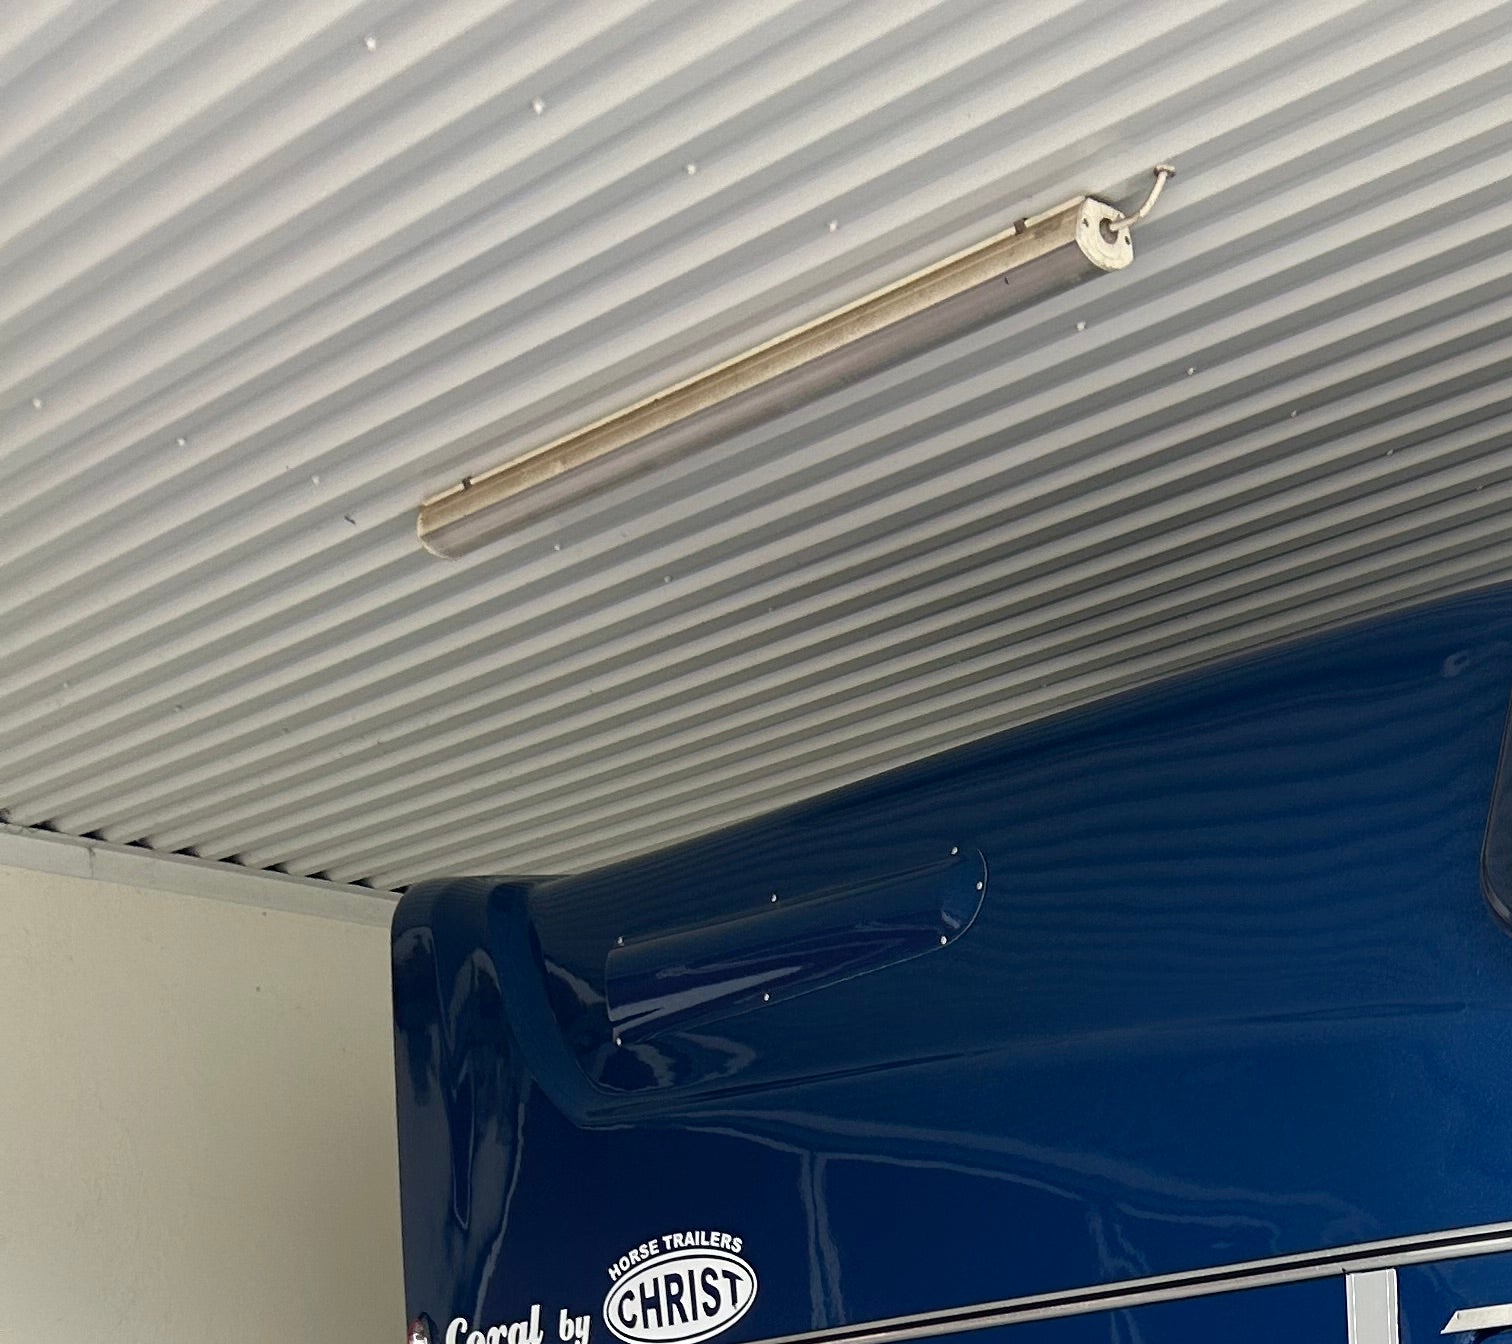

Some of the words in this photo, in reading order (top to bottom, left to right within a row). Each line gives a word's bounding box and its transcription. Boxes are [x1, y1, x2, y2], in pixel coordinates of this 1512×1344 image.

[608, 1239, 659, 1282] HORSE
[662, 1231, 743, 1253] TRAILERS
[617, 1267, 744, 1330] CHRIST
